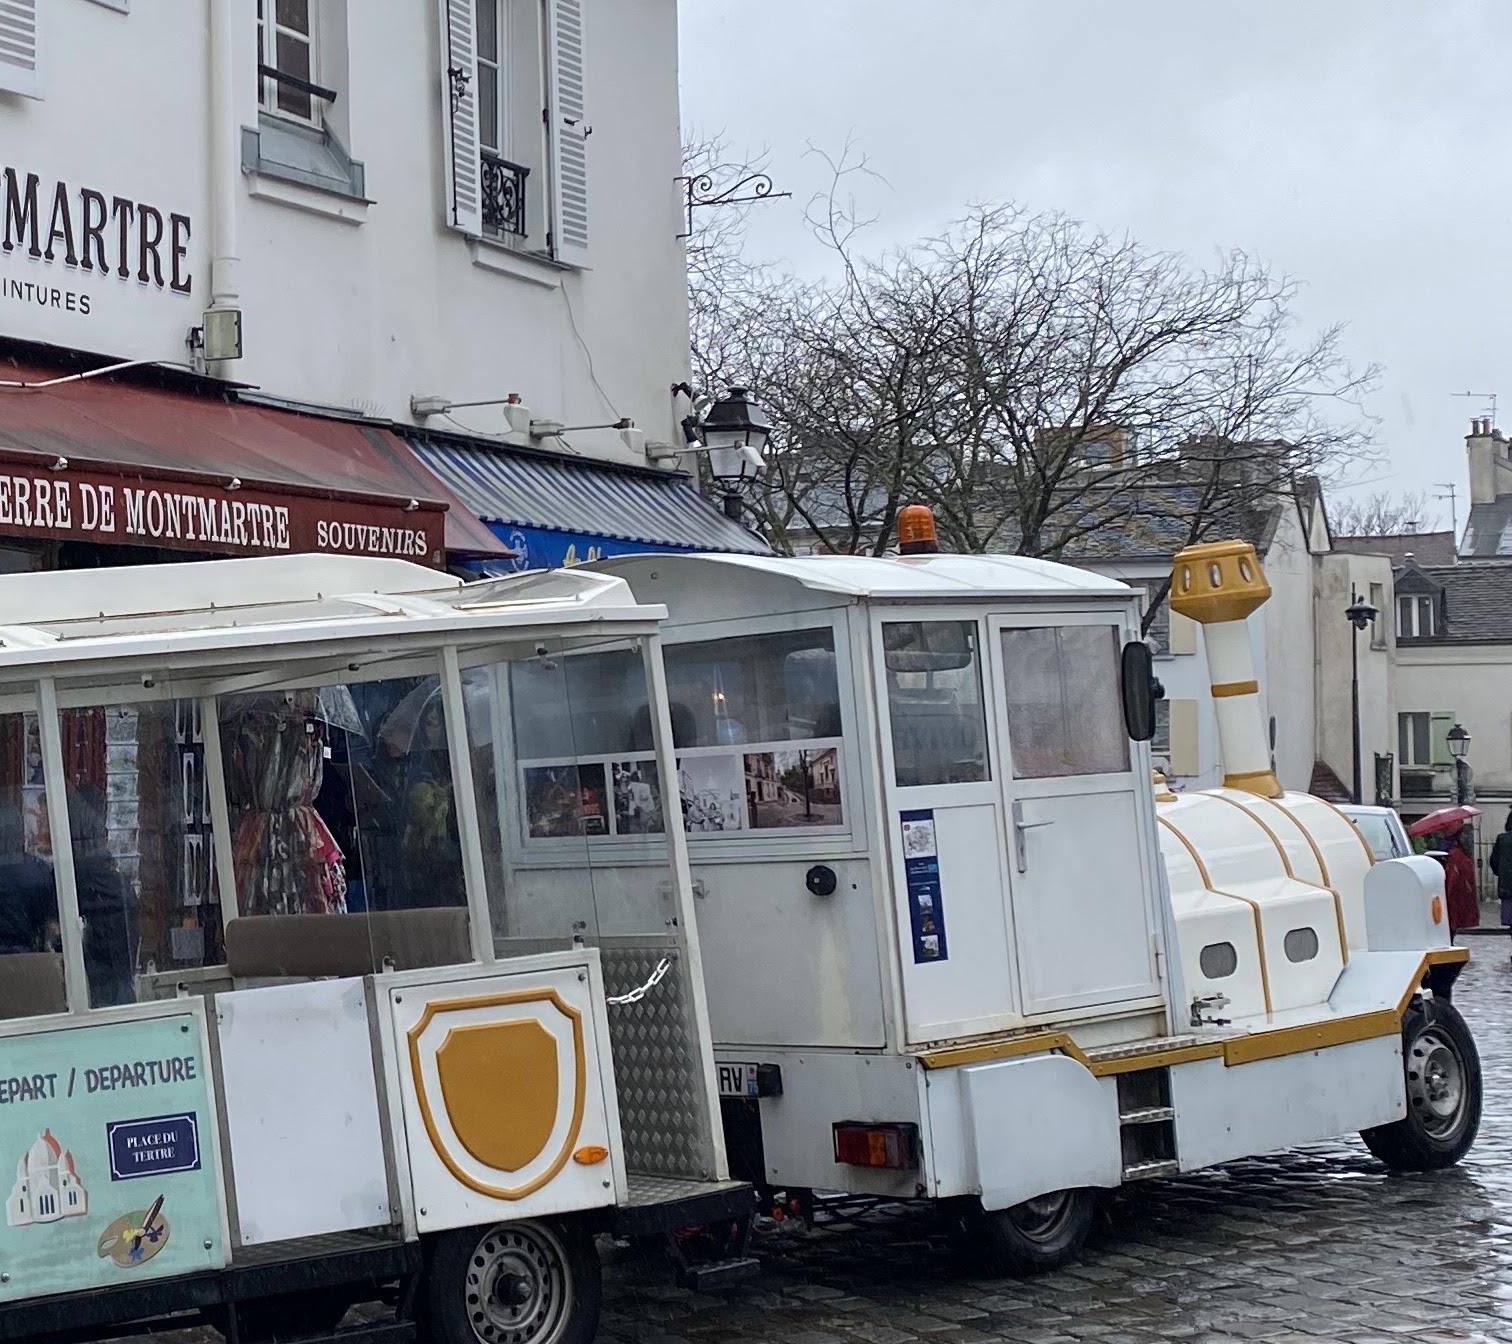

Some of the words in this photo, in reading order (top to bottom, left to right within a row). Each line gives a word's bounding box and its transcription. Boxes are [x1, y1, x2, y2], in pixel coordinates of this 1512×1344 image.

[79, 482, 116, 533] DE
[123, 487, 290, 550] MONTMARTRE
[316, 519, 428, 557] SOUVENIRS
[66, 1066, 76, 1098] /
[83, 1055, 196, 1094] DEPARTURE
[126, 1133, 162, 1149] PLACE
[162, 1130, 178, 1144] DU
[131, 1146, 176, 1163] TERTRE
